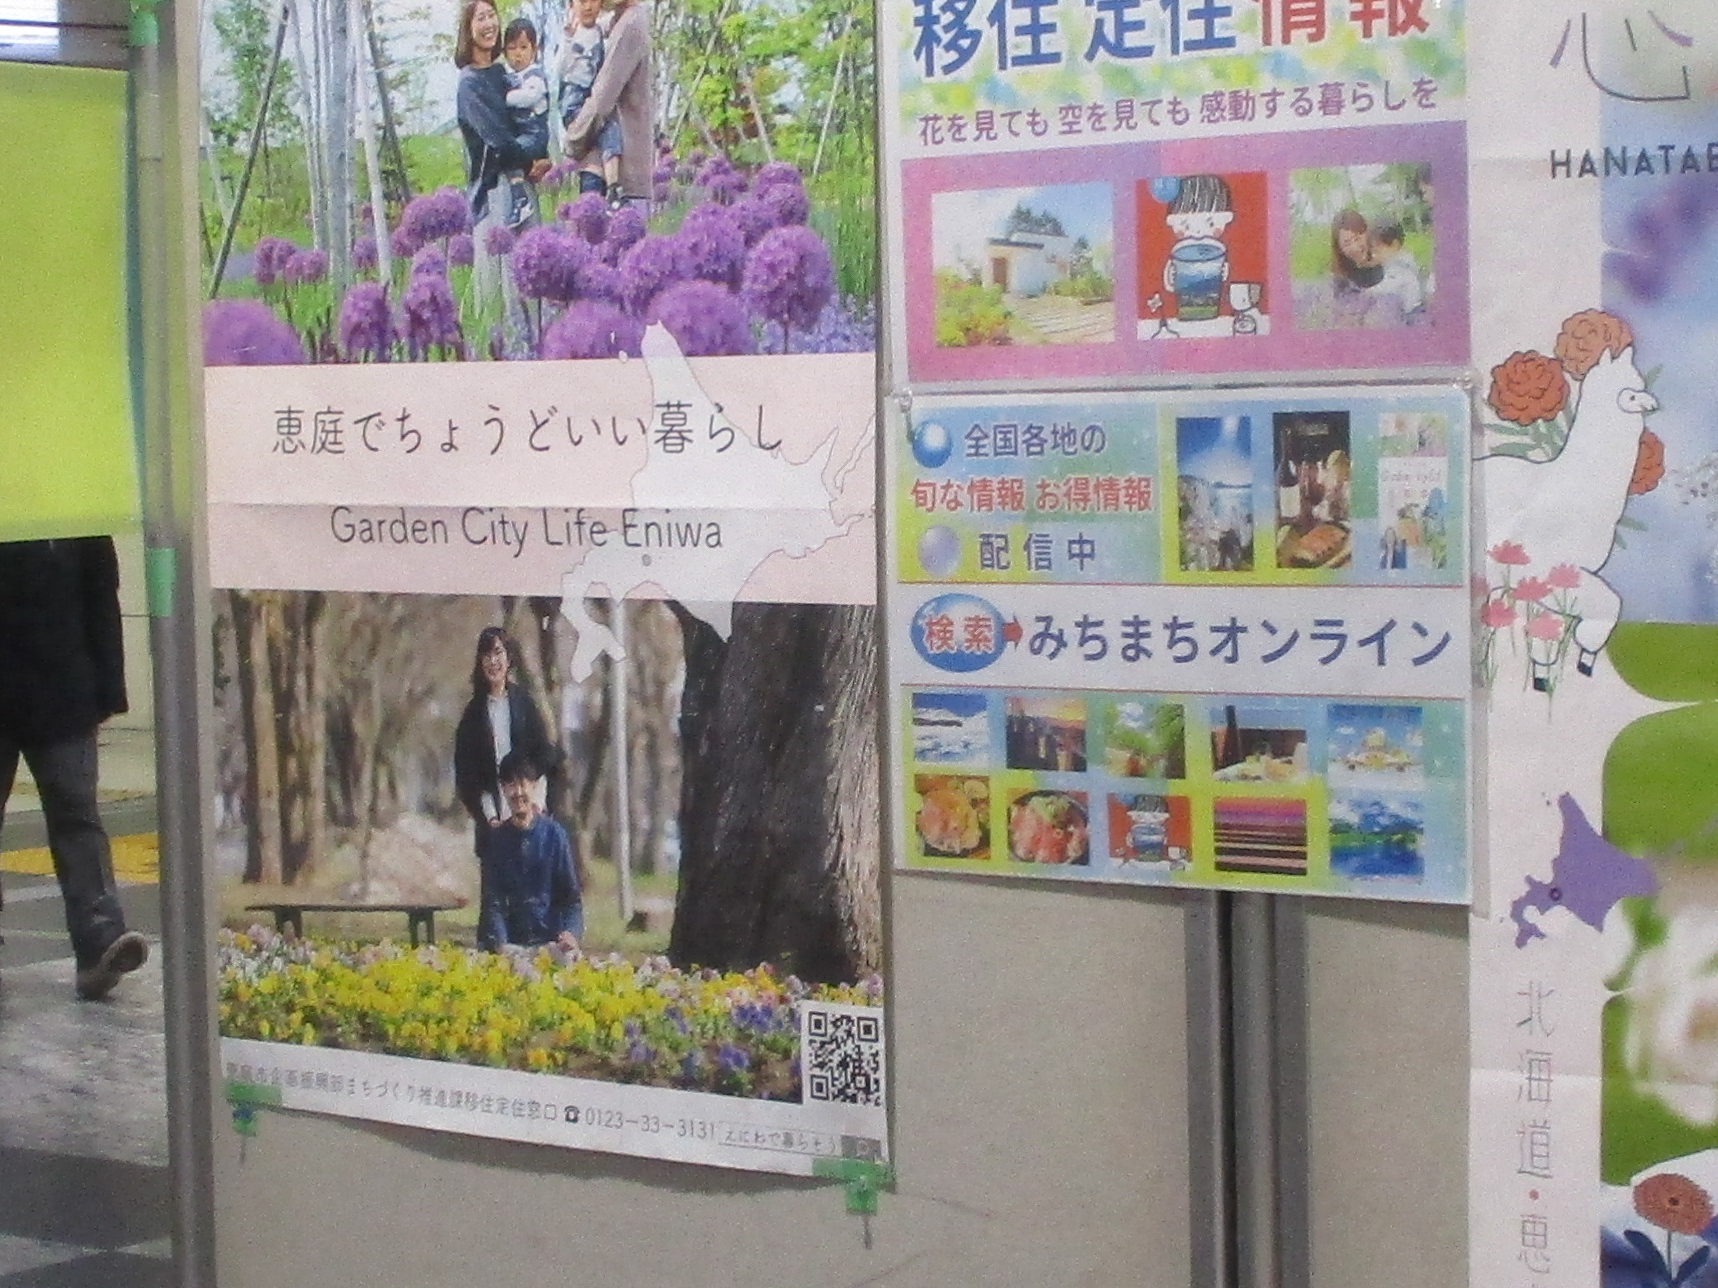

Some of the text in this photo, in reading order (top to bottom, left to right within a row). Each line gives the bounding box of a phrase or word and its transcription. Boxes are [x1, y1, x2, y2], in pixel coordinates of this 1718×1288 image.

[271, 400, 783, 456] 恵庭でちょうどいい暮らし
[964, 421, 1107, 460] 全国各地の
[330, 506, 724, 560] Garden City Life Eniwa
[979, 532, 1098, 572] 配信中
[924, 613, 1452, 667] 検索 みちまちオンライン
